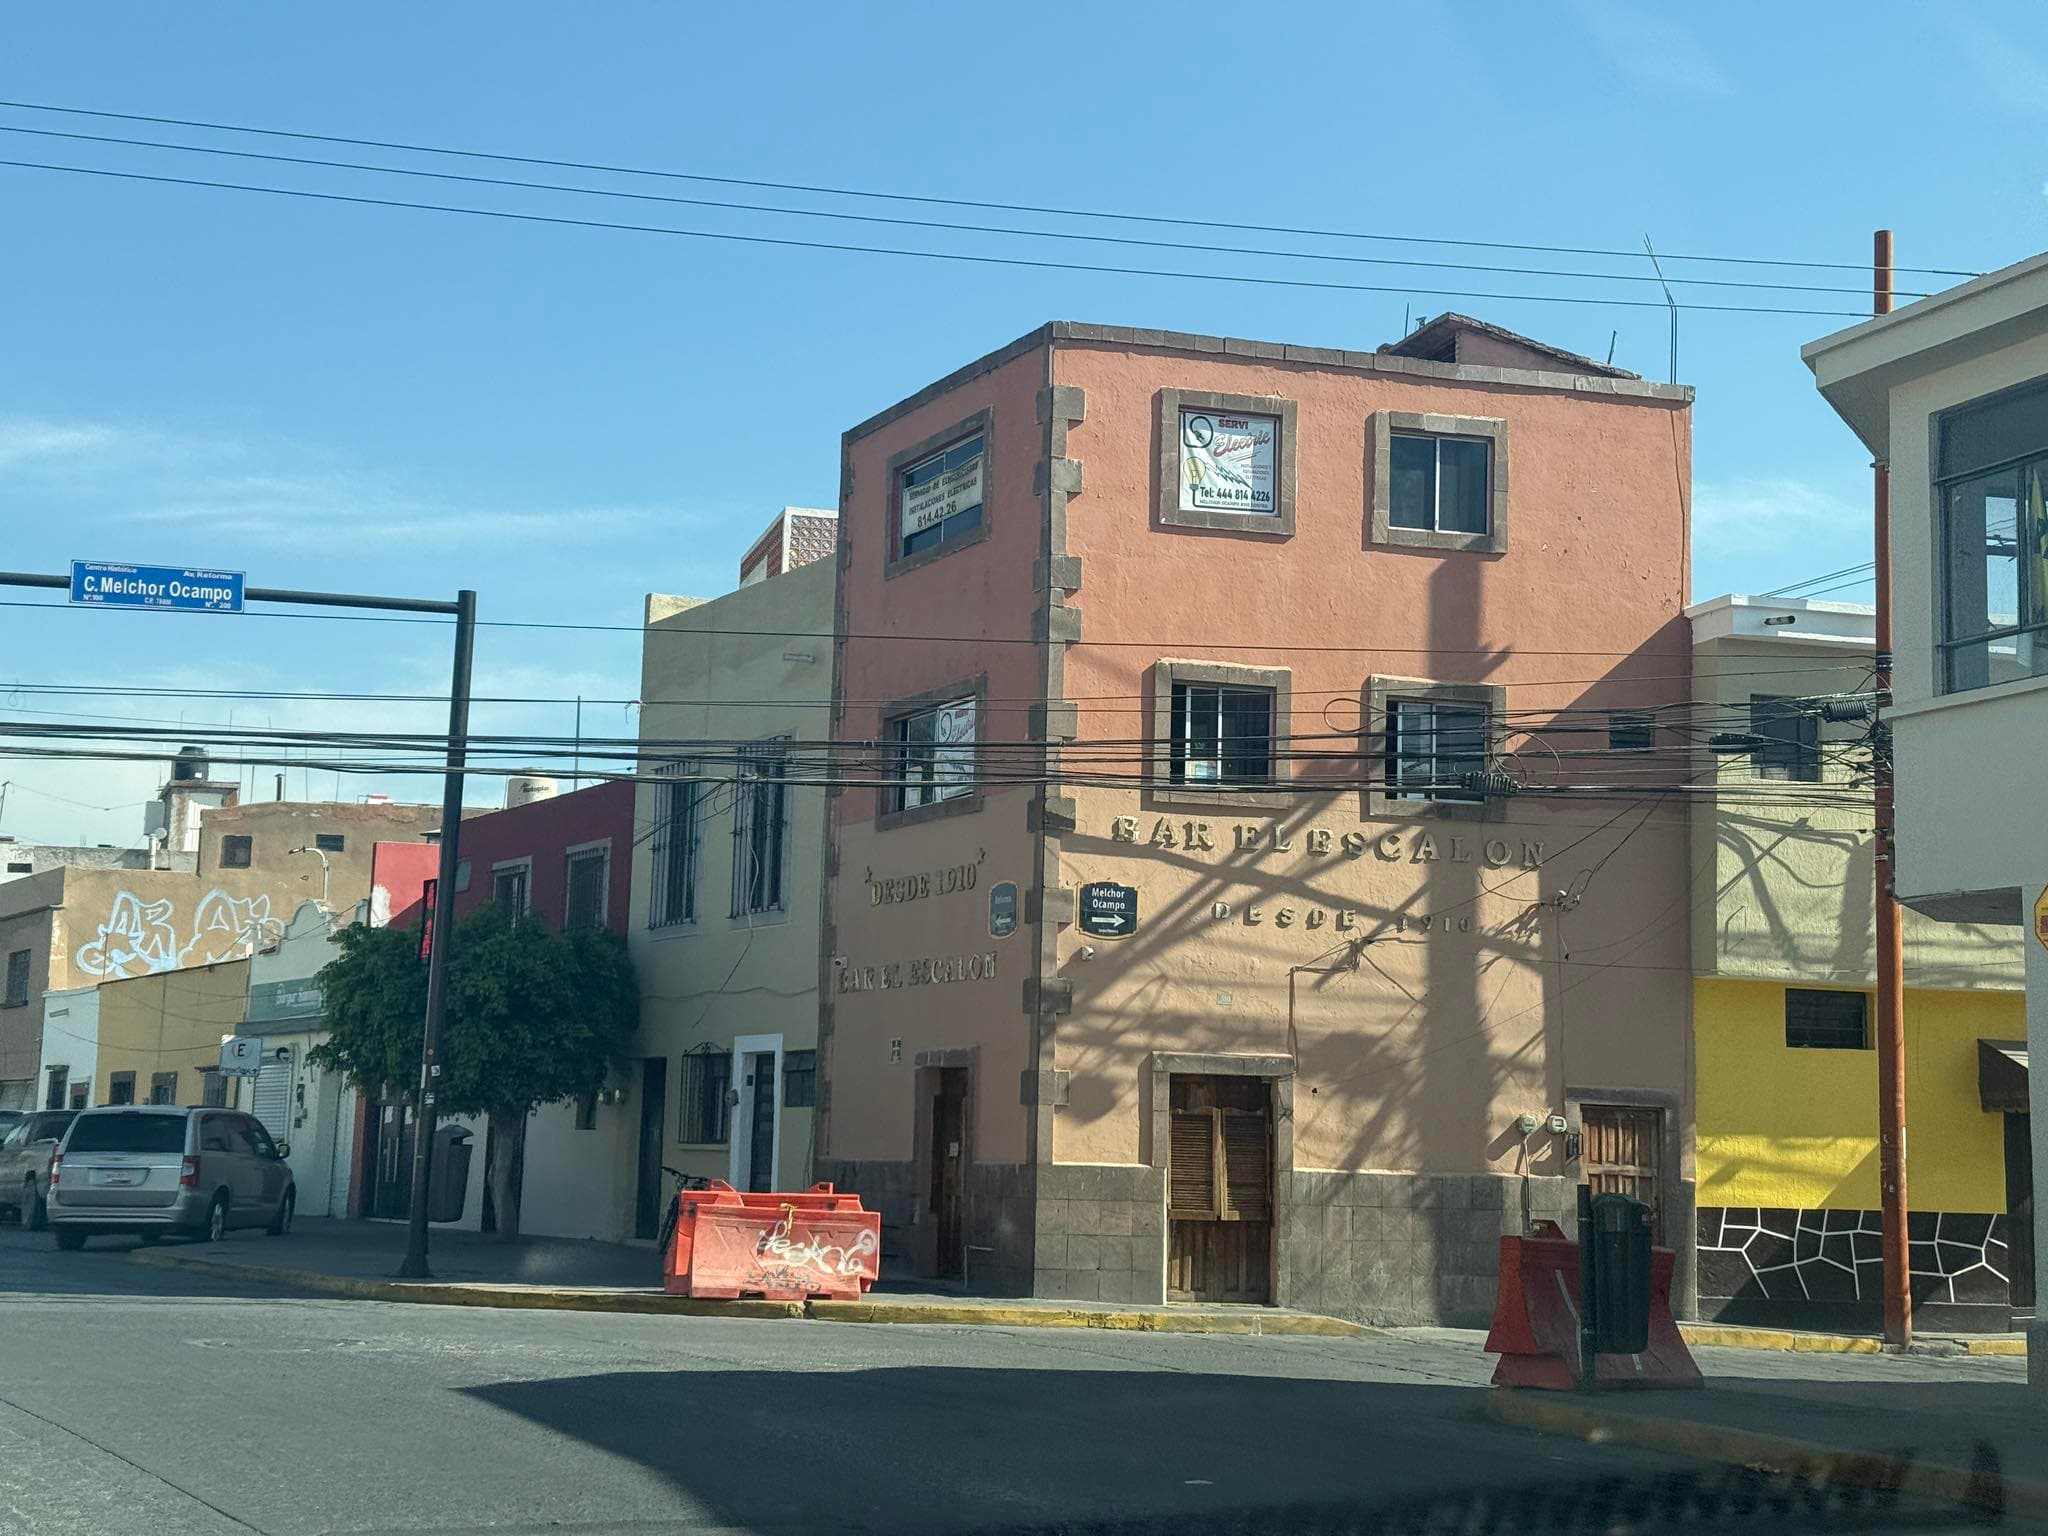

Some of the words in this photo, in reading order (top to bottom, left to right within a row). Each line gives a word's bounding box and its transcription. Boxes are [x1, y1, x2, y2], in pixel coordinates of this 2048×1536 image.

[1218, 419, 1249, 430] SERVI
[1217, 488, 1233, 499] 444
[1235, 489, 1249, 500] 814
[1251, 490, 1271, 502] 4226
[917, 501, 957, 528] 814.42.26
[85, 563, 107, 571] Centro
[196, 571, 233, 580] Reforma
[84, 576, 98, 592] C.
[101, 577, 166, 596] Melchor
[169, 581, 232, 603] Ocampo
[1112, 815, 1214, 851] BAR
[1233, 823, 1293, 853] EL
[1306, 828, 1545, 871] ESCALON
[871, 872, 930, 907] DESDE
[935, 863, 977, 896] 1910
[1092, 887, 1125, 898] Melchor
[1092, 899, 1126, 911] Ocampo
[1211, 901, 1357, 931] DESDE
[837, 967, 874, 994] BAR
[880, 964, 903, 989] EL
[908, 951, 997, 986] ESCALON
[237, 1043, 247, 1057] E
